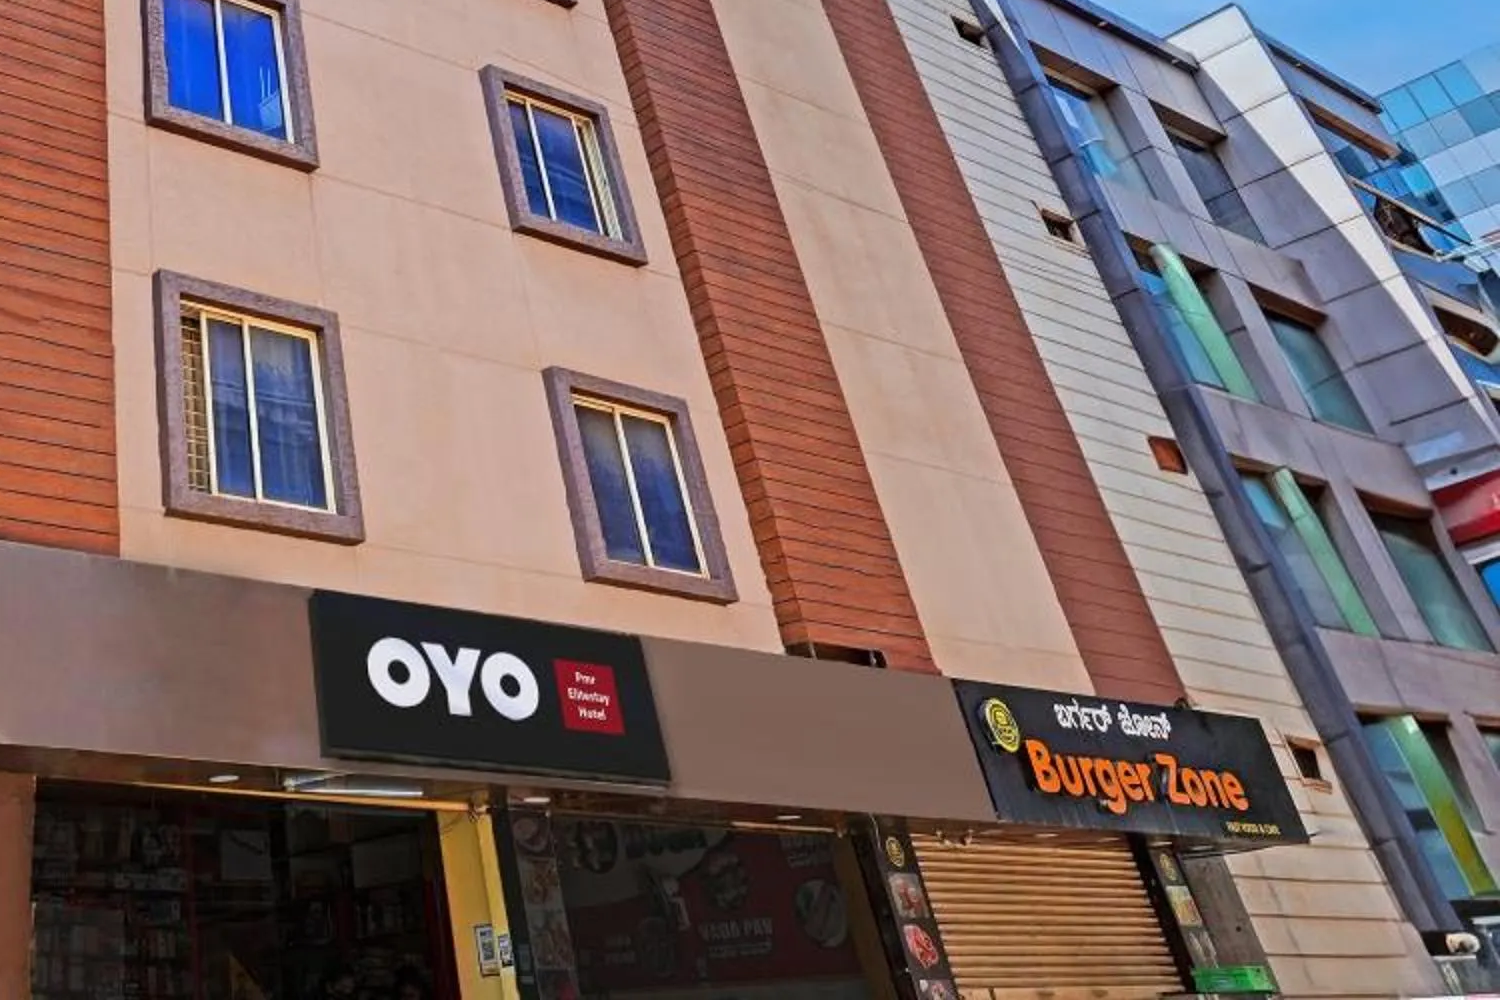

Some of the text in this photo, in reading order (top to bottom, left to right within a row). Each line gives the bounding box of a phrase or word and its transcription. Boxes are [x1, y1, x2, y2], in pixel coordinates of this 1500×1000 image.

[366, 636, 539, 722] OYO
[578, 706, 607, 721] Hotel
[1026, 739, 1250, 815] Burger Zone
